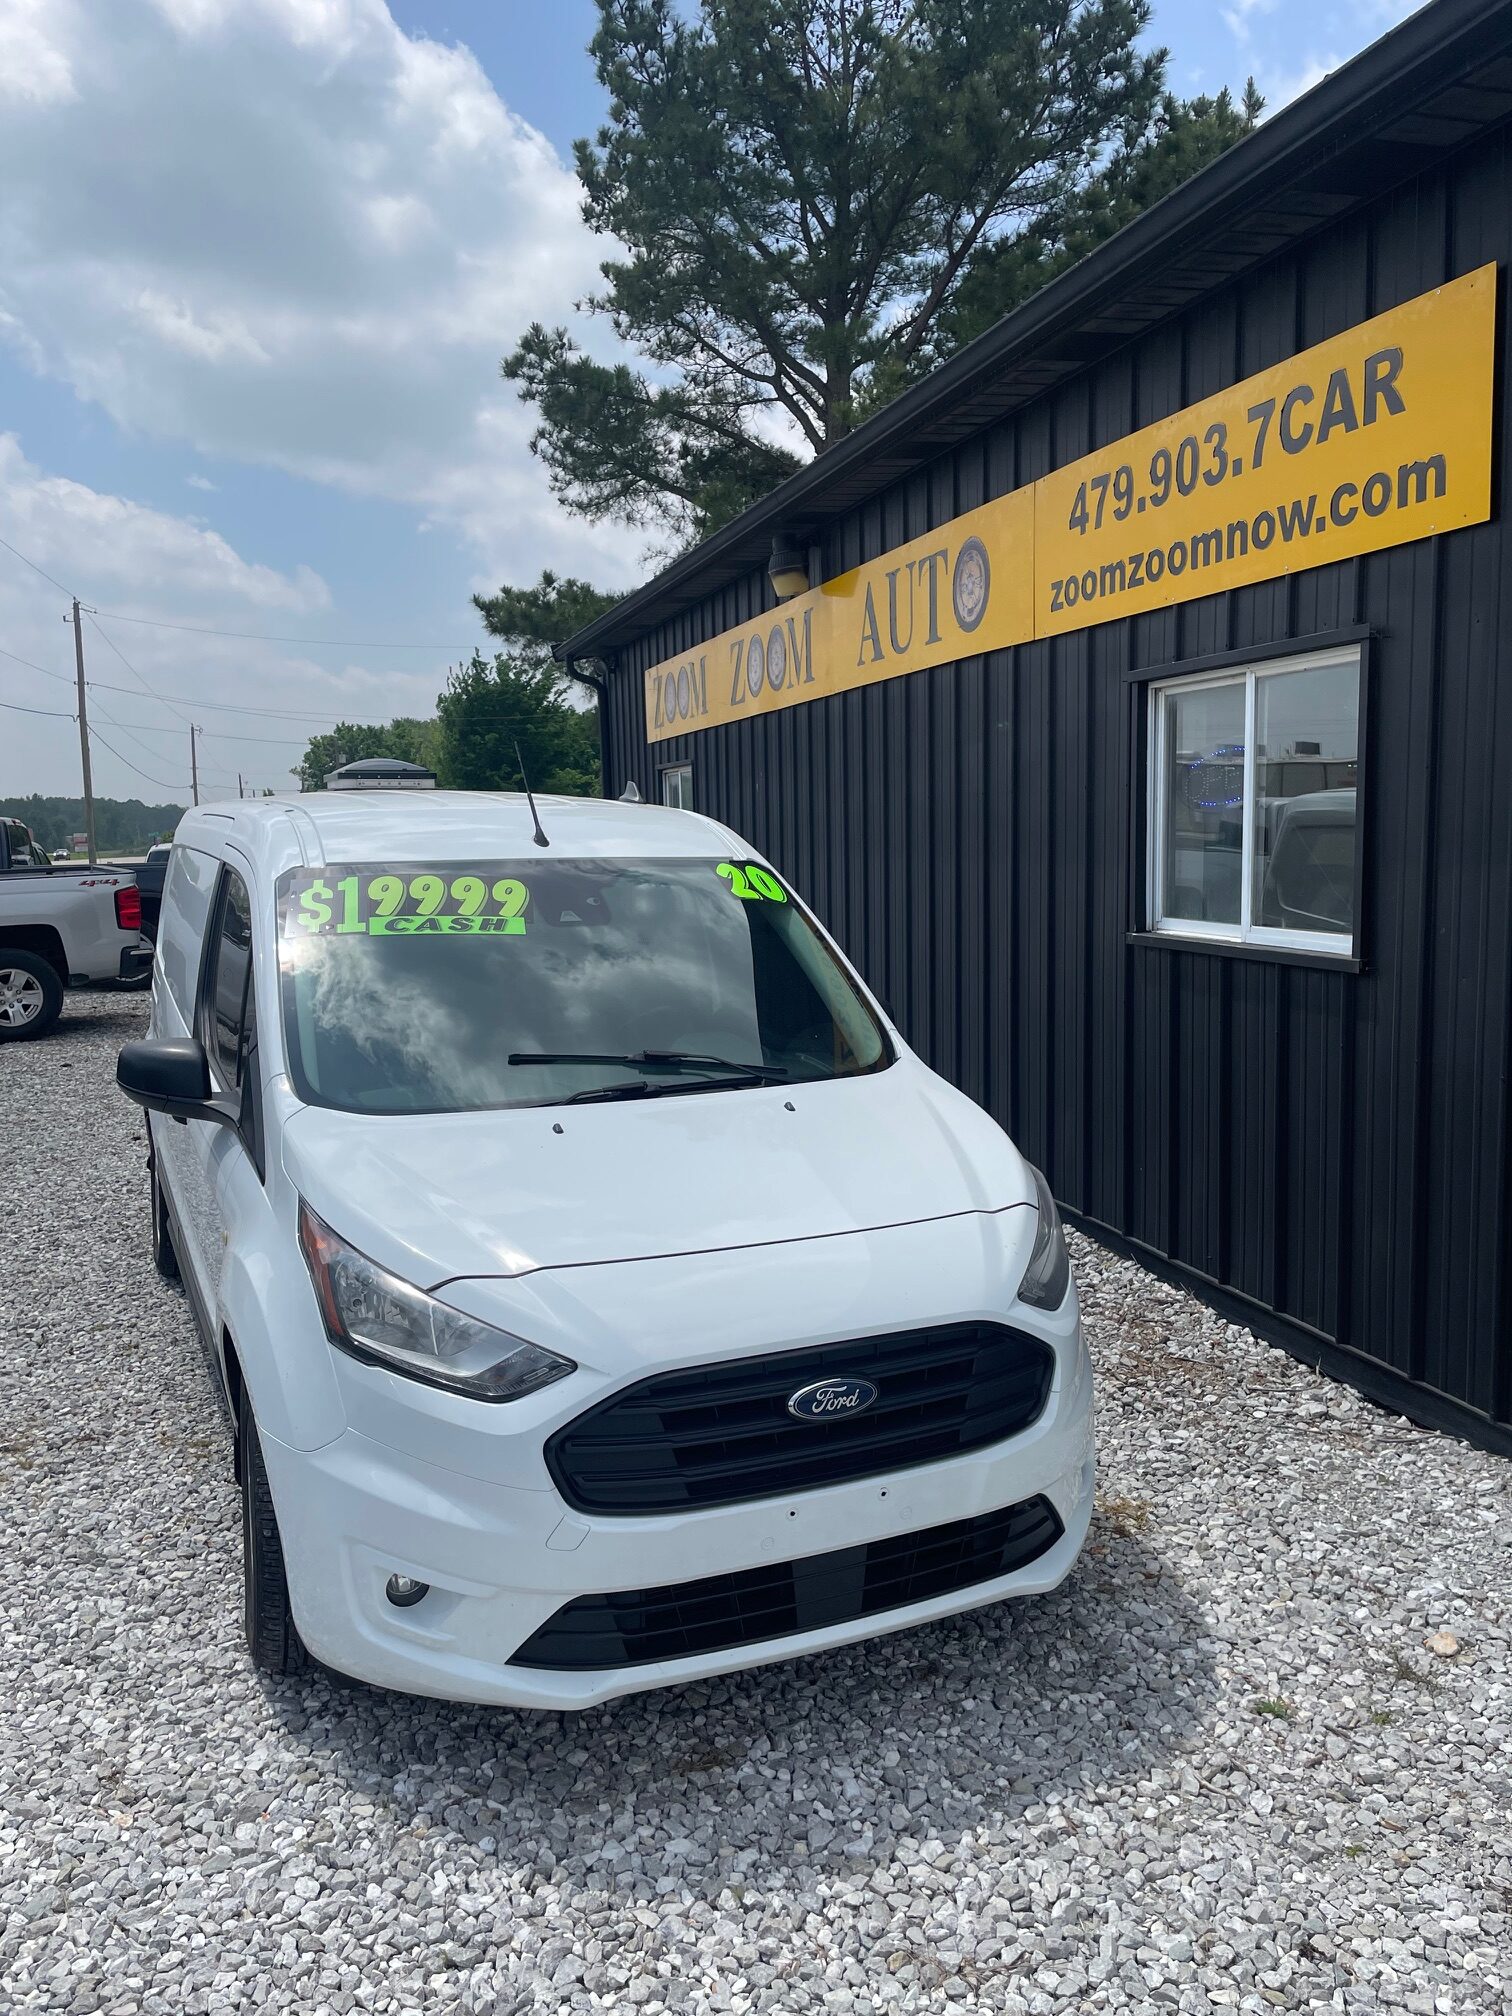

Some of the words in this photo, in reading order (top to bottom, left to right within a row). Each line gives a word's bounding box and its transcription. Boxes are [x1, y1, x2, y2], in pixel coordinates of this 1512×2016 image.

[1069, 347, 1406, 535] 479.903.7CAR
[1050, 453, 1447, 613] zoomzoomnow.com
[653, 654, 708, 730] ZOOM
[729, 606, 816, 706] ZOOM
[857, 535, 991, 667] AUTO
[297, 875, 530, 933] $19999
[716, 863, 788, 903] 20
[384, 917, 509, 932] CASH
[811, 1385, 860, 1413] Ford
